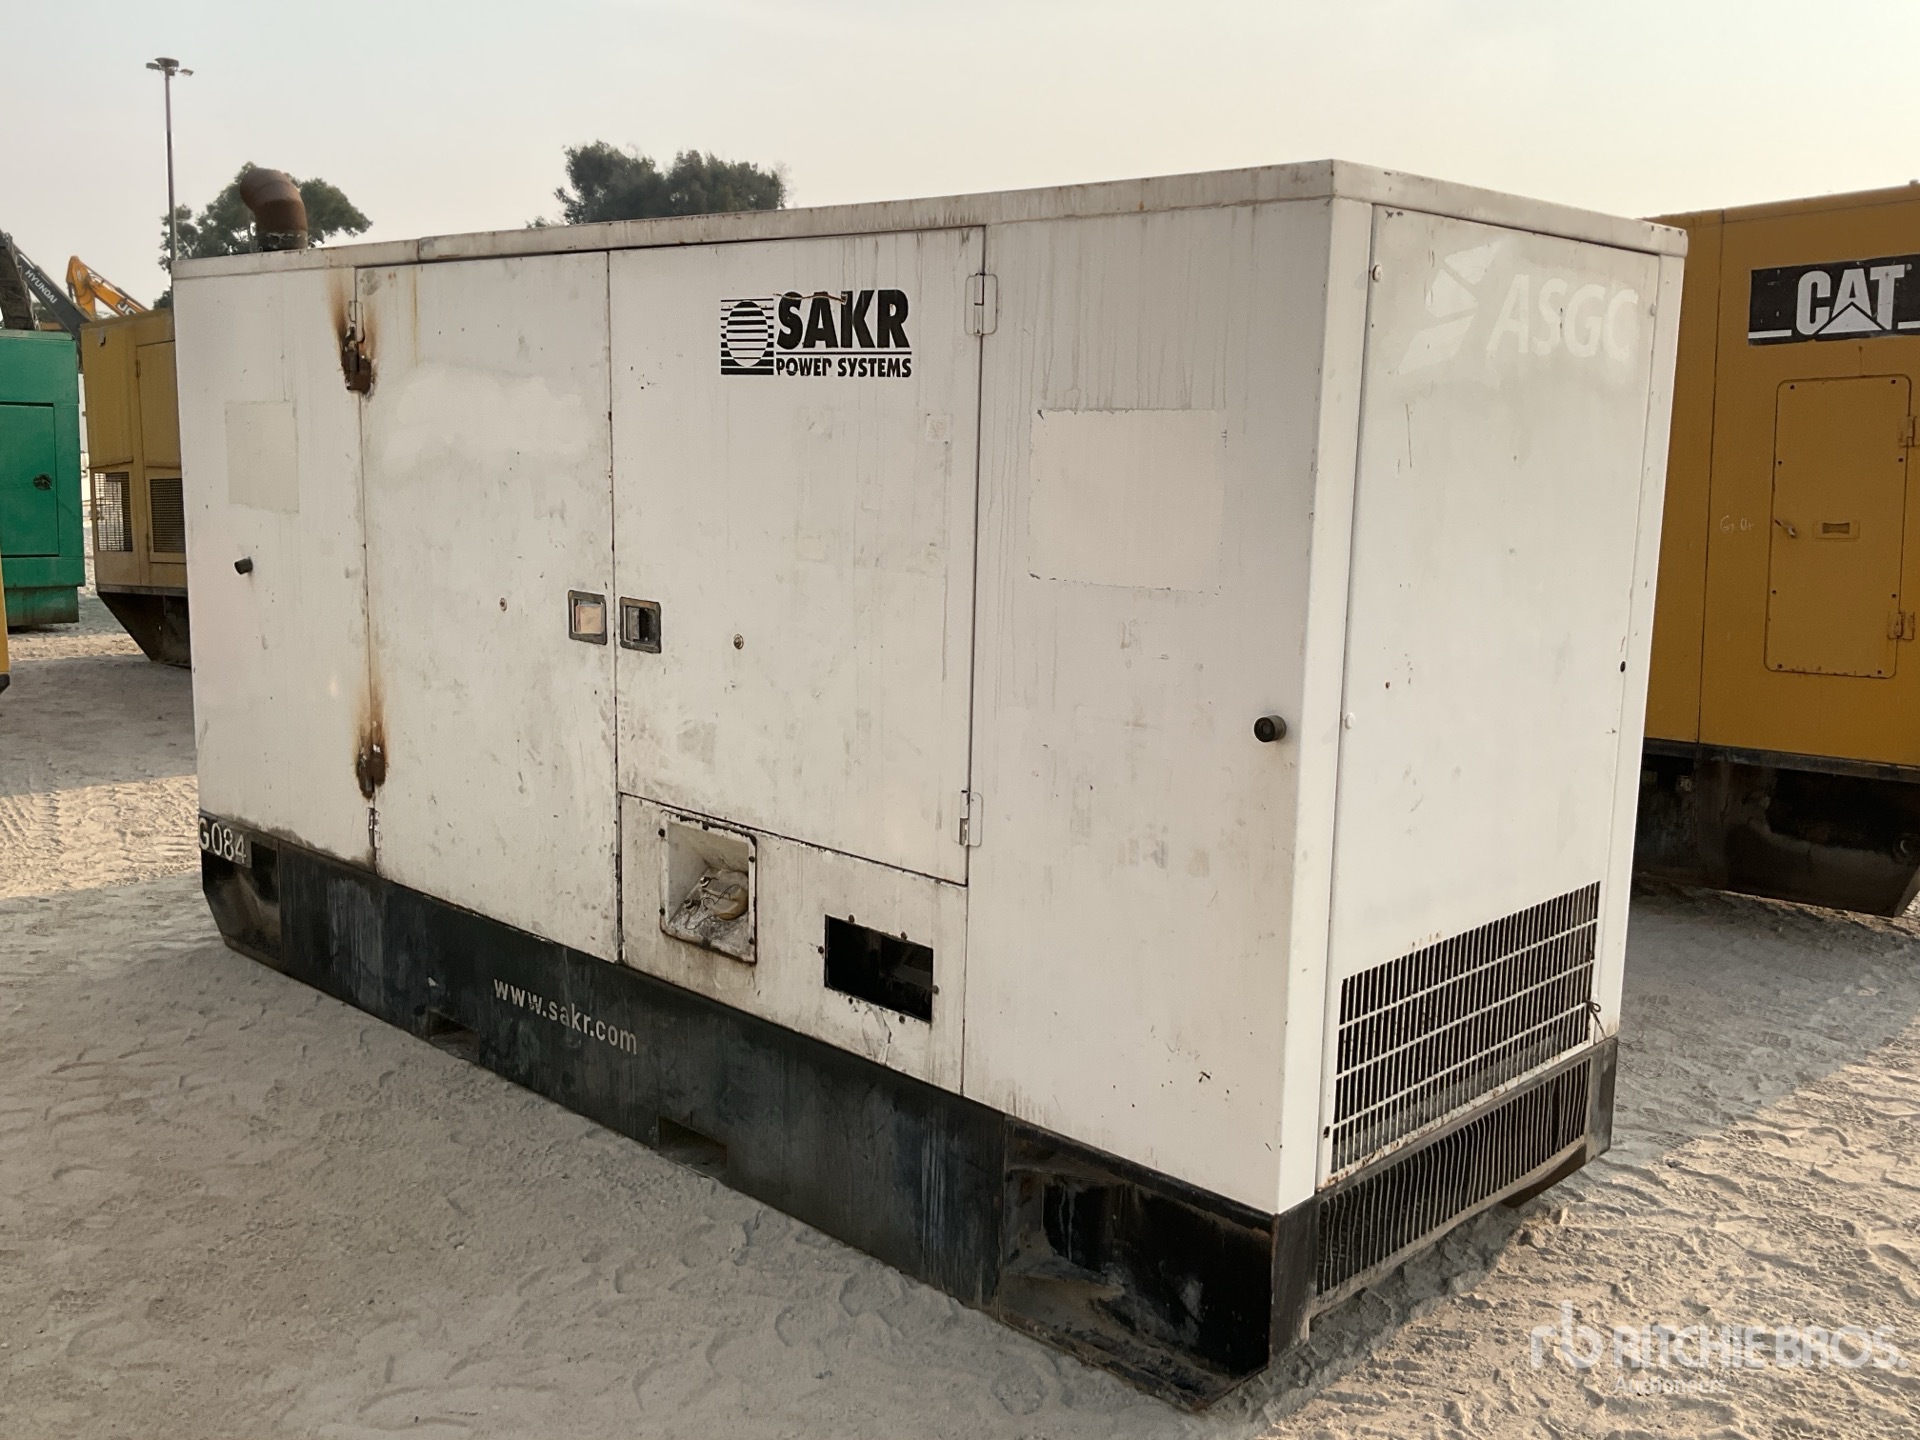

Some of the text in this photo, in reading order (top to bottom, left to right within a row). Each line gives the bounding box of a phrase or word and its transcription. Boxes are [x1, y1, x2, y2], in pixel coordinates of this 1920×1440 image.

[25, 269, 58, 304] HYUNDAI
[117, 301, 137, 316] JC
[1796, 264, 1905, 335] CAT
[777, 289, 910, 350] SAKR
[1486, 273, 1639, 362] ASGC
[776, 357, 912, 378] POWER SYSTEMS
[199, 817, 247, 864] G084
[494, 978, 637, 1055] www.sakr.com
